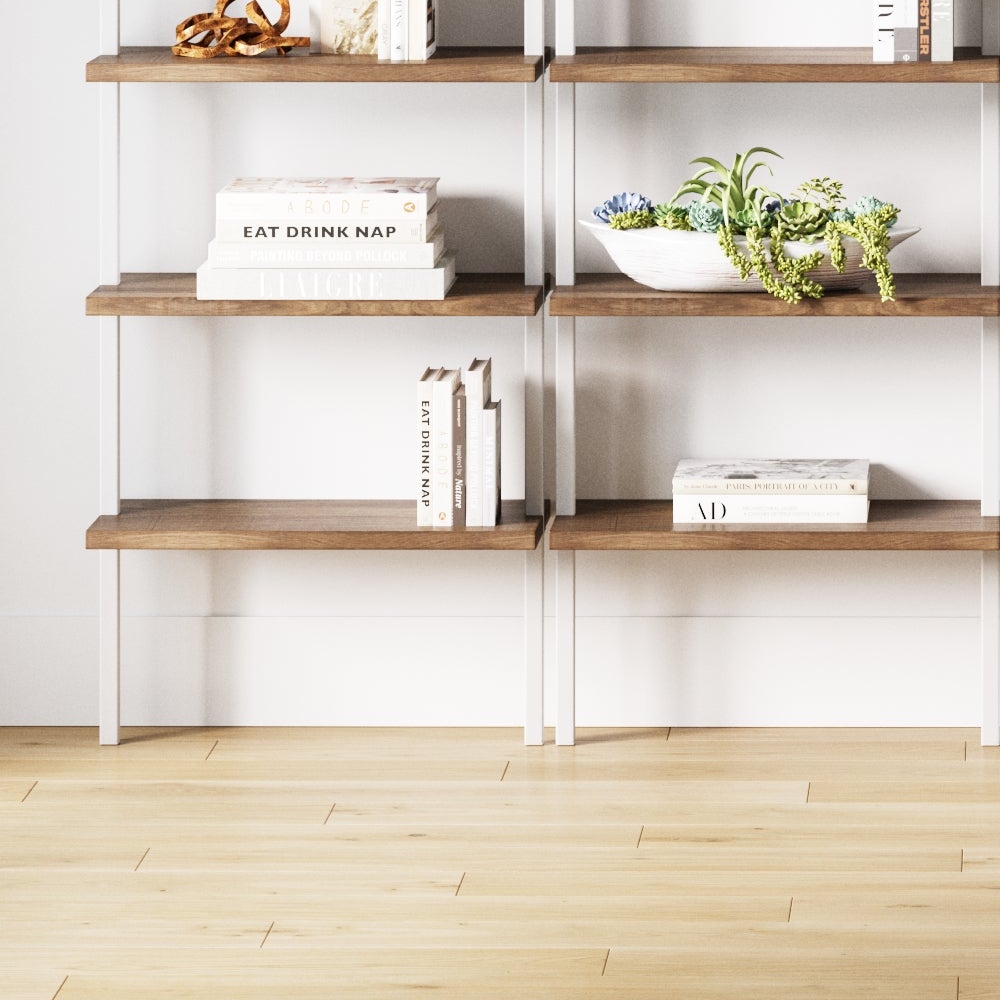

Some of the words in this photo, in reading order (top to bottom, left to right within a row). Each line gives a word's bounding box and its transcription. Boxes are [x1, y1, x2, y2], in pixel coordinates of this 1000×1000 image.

[243, 225, 280, 239] EAT
[286, 225, 350, 239] DRINK
[355, 225, 398, 239] NAP
[421, 400, 430, 426] EAT
[421, 430, 430, 474] DRINK
[421, 479, 430, 507] NAP
[455, 478, 464, 509] Nature
[691, 502, 727, 520] AD
